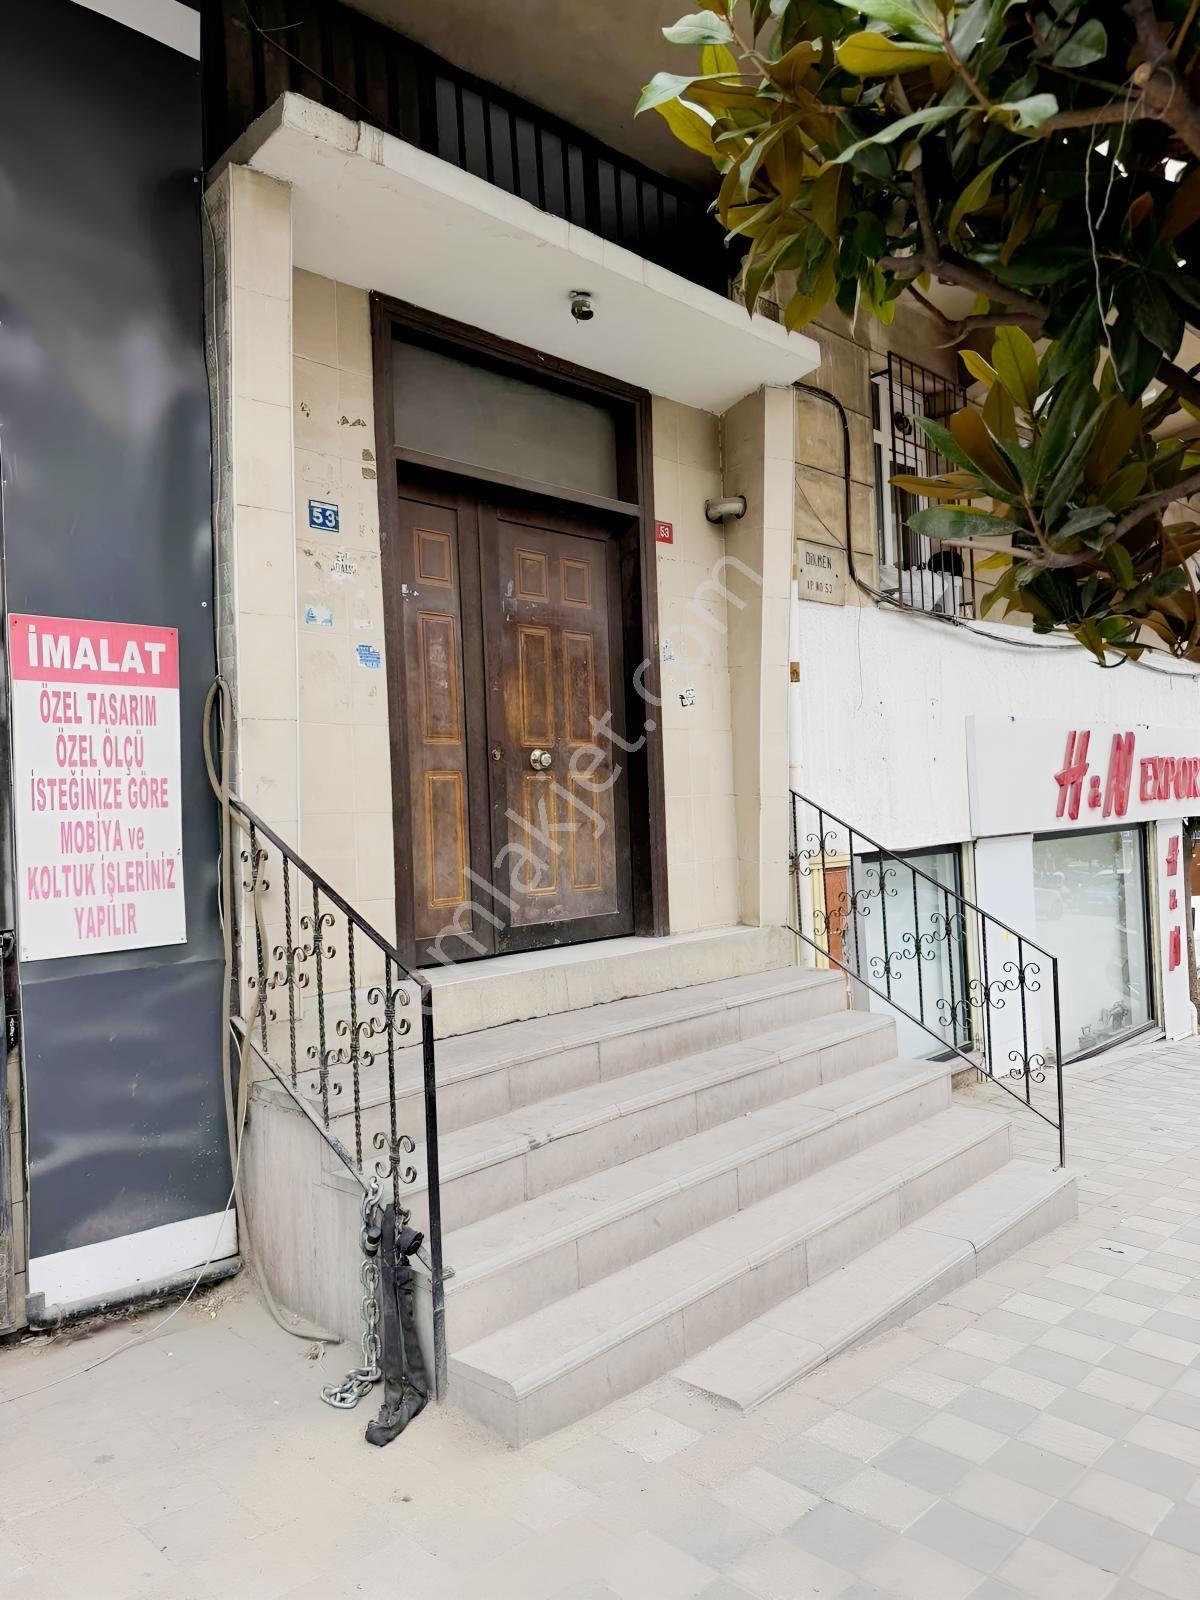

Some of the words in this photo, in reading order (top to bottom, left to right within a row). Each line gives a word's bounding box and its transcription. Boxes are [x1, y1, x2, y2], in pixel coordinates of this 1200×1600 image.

[312, 508, 336, 527] 53
[659, 526, 670, 538] 53
[28, 624, 166, 675] İMALAT
[40, 683, 83, 724] ÖZEL
[87, 692, 157, 726] TASARIM
[56, 727, 98, 768] ÖZEL
[103, 728, 144, 776] ÖLÇÜ
[31, 769, 123, 812] İSTEĞİNİZE
[127, 770, 169, 810] GÖRE
[60, 812, 123, 854] MOBİYA
[128, 826, 145, 850] ve
[27, 863, 96, 900] KOLTUK
[101, 850, 176, 903] İŞLERİNİZ
[74, 902, 137, 939] YAPILIR
